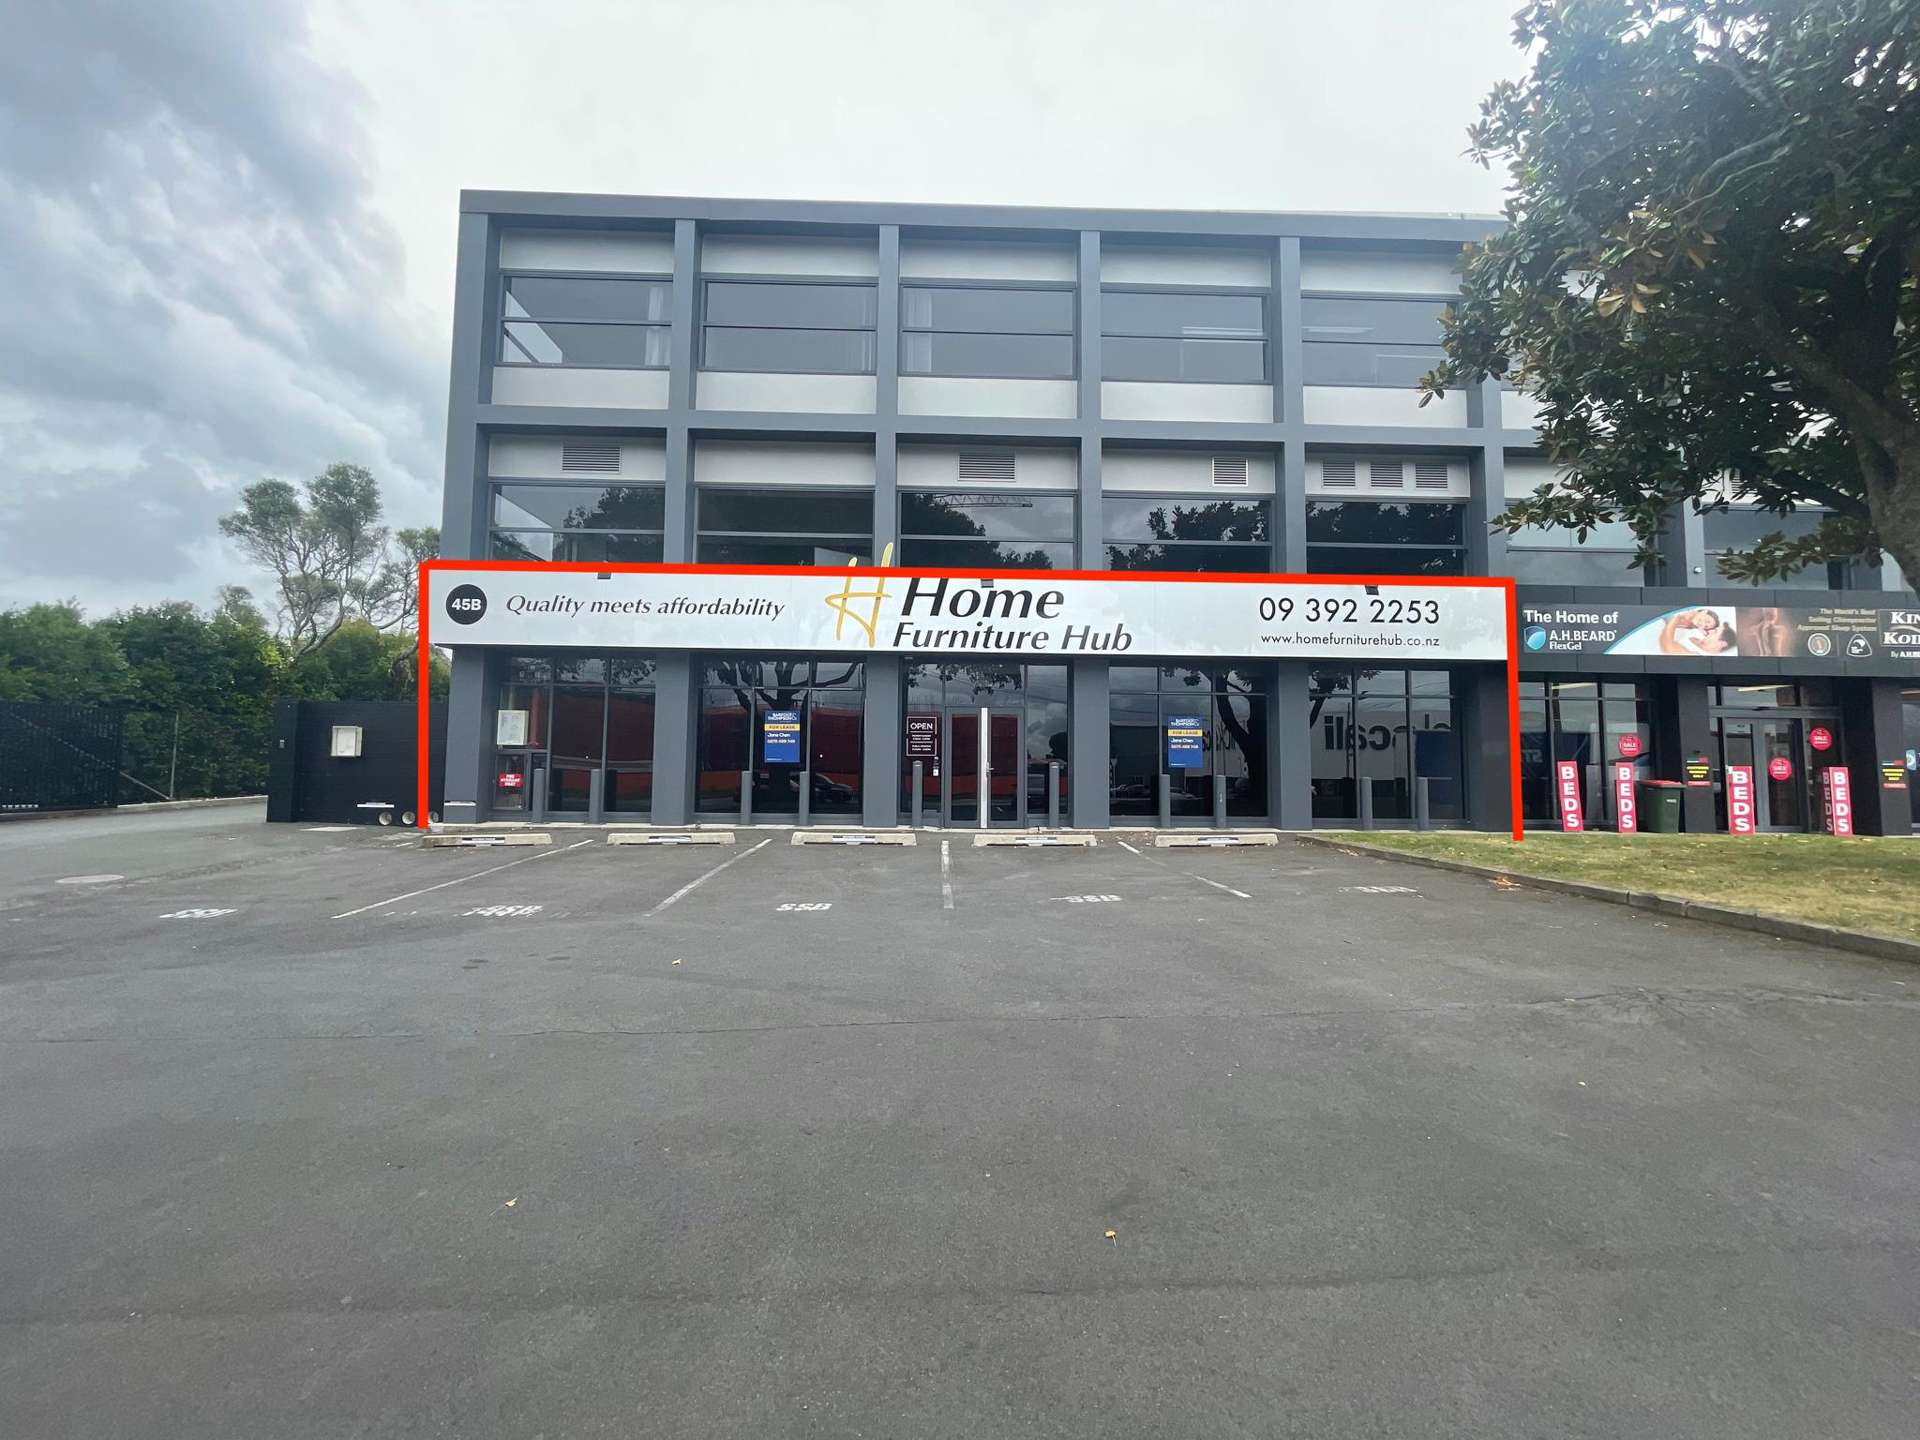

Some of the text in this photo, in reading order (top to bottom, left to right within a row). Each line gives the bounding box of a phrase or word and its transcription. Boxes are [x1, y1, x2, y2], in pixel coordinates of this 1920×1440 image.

[451, 598, 481, 611] 45B
[506, 595, 785, 622] Quality meets affordability
[901, 578, 1064, 619] Home
[1259, 597, 1440, 624] 09 392 2253
[1523, 609, 1619, 624] The Home of
[893, 621, 1132, 651] Furniture Hub
[1261, 632, 1440, 647] www.homefurniturehub.co.nz
[1549, 629, 1616, 642] A.H.BEARD
[1549, 641, 1582, 651] FlexGel
[910, 722, 933, 730] OPEN
[1561, 766, 1579, 828] BEDS
[1619, 767, 1633, 828] BEDS
[1732, 771, 1750, 832] BEDS
[1833, 771, 1849, 832] BEDS
